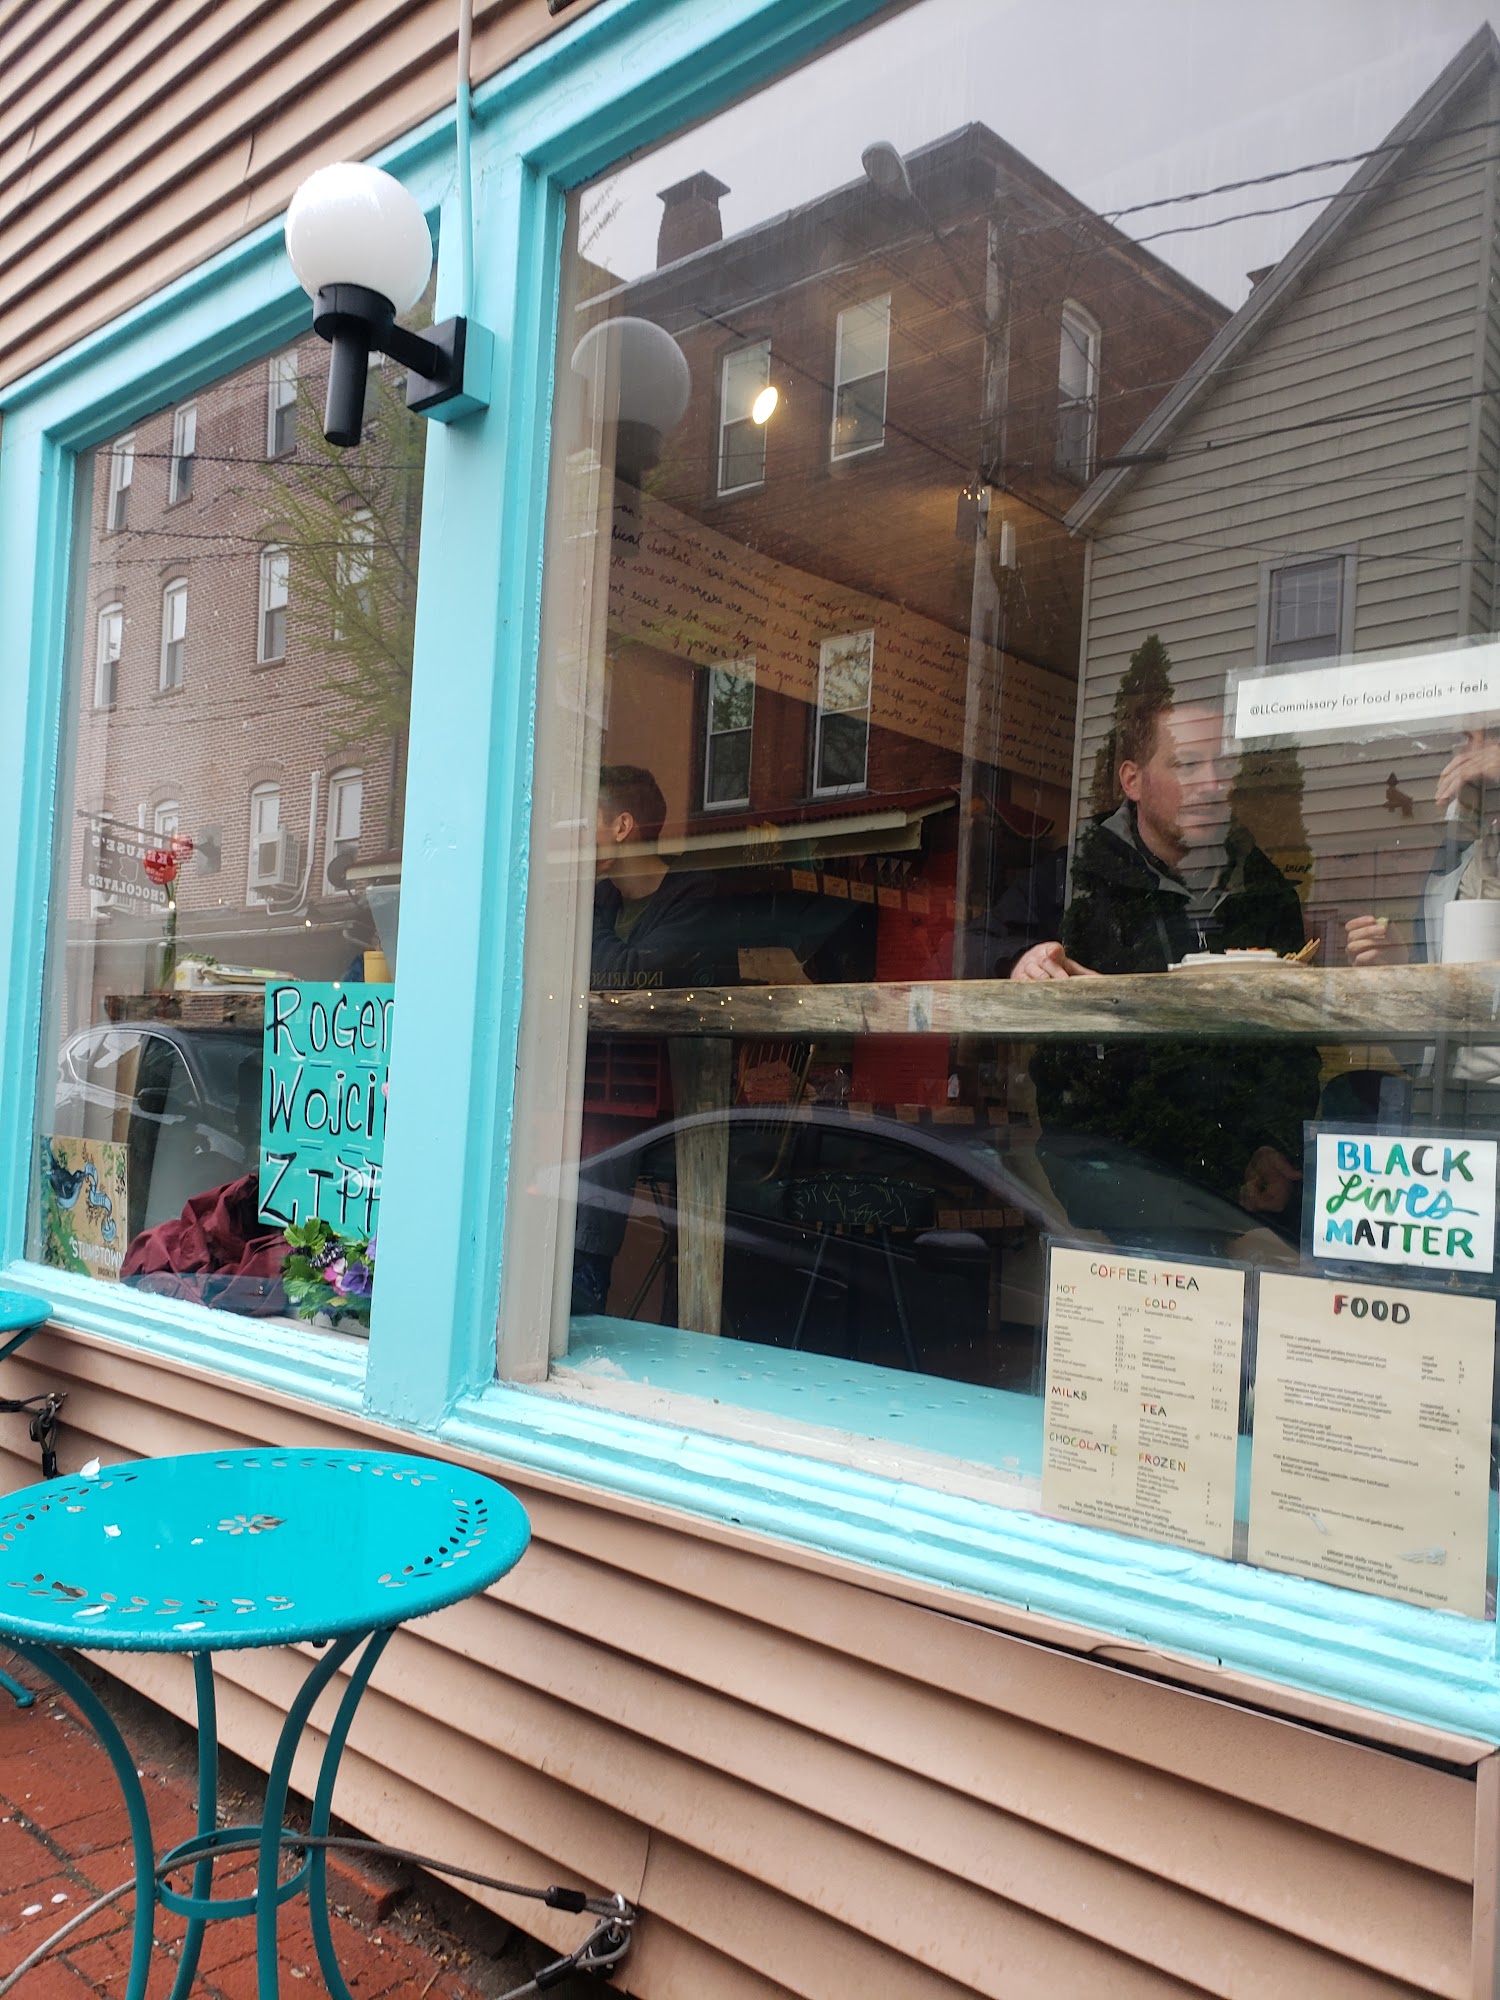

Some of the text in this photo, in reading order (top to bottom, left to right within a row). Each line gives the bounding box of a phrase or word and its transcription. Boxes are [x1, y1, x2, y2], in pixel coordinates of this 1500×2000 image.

[1249, 697, 1338, 717] @LLCommissary
[1342, 693, 1359, 708] for
[1362, 690, 1391, 706] food
[1395, 684, 1442, 703] specials
[1460, 679, 1488, 695] feels
[1336, 1140, 1474, 1182] BLACK
[1325, 1173, 1480, 1220] Lives
[1324, 1217, 1475, 1260] MATTER
[72, 1240, 125, 1269] STUMPTOWN
[1056, 1283, 1077, 1295] HOT
[1090, 1262, 1148, 1286] COFFEE
[1162, 1272, 1200, 1292] TEA
[1144, 1296, 1177, 1311] COLD
[1333, 1294, 1411, 1325] FOOD
[1051, 1386, 1088, 1401] MILKS
[1140, 1403, 1168, 1418] TEA
[1049, 1432, 1119, 1457] CHOCOLATE
[1138, 1453, 1187, 1473] FROZEN
[1264, 1550, 1280, 1558] check
[1280, 1554, 1295, 1562] social
[1382, 1580, 1397, 1588] food
[1396, 1584, 1408, 1592] and
[1408, 1587, 1424, 1596] drink
[1354, 1555, 1367, 1564] daily
[1354, 1563, 1374, 1573] special
[1373, 1568, 1399, 1580] offerings
